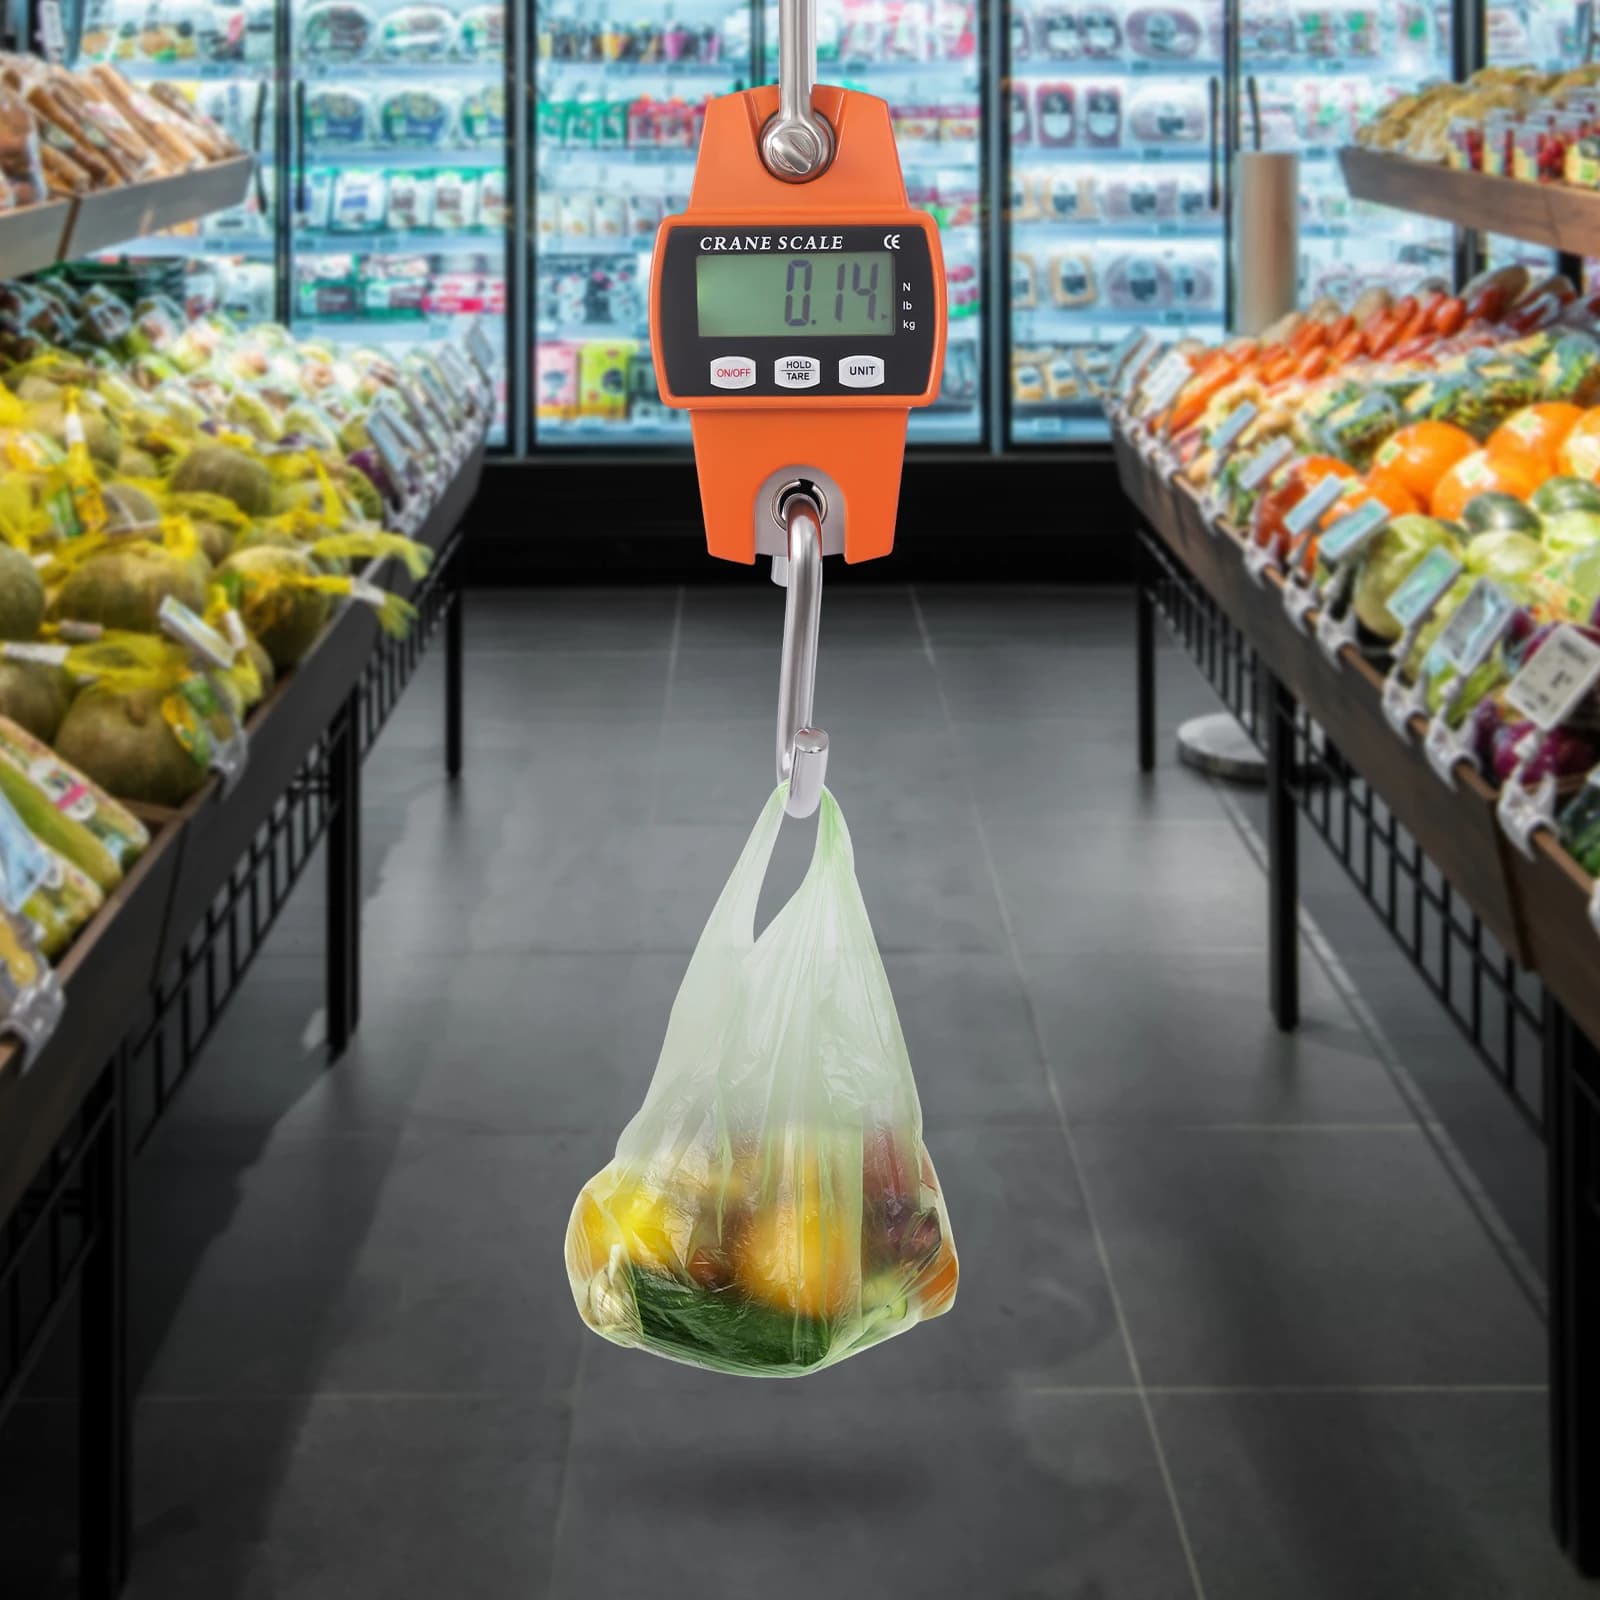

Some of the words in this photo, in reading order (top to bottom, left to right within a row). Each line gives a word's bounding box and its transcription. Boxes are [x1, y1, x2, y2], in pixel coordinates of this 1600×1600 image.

[700, 236, 772, 250] CRANE
[778, 235, 843, 250] SCALE
[883, 234, 901, 249] CE
[903, 282, 911, 291] N
[903, 301, 912, 311] lb
[903, 319, 916, 330] kg
[786, 360, 812, 370] HOLD
[716, 368, 751, 378] ON/OFF
[849, 366, 876, 376] UNIT
[786, 372, 810, 381] TARE
